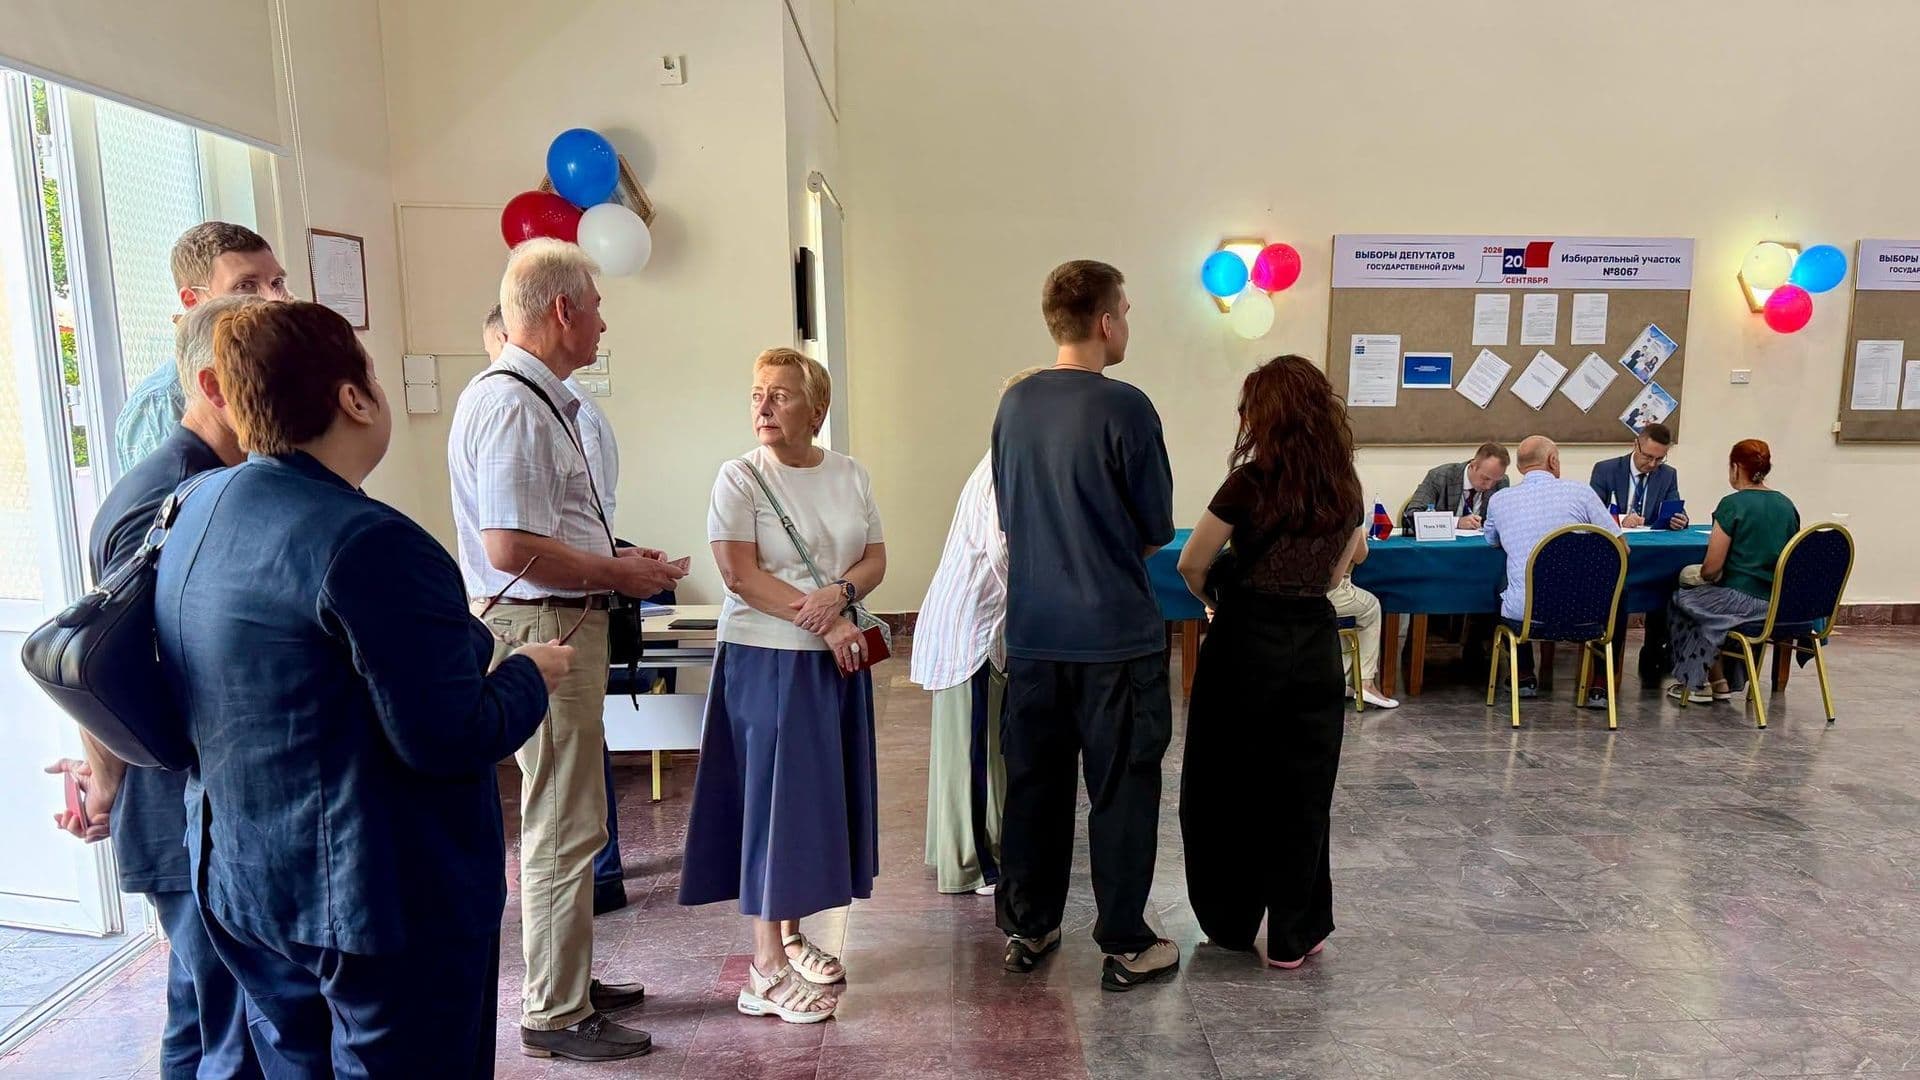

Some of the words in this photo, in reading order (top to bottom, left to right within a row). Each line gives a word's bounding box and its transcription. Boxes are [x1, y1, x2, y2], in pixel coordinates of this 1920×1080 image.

[1483, 246, 1503, 254] 2026
[1354, 251, 1397, 259] ВЫБОРЫ
[1399, 251, 1456, 260] ДЕПУТАТОВ
[1561, 254, 1640, 265] Избирательный
[1641, 256, 1681, 266] участок
[1879, 254, 1919, 263] ВЫБОРЫ
[1504, 255, 1523, 268] 20
[1366, 262, 1441, 271] ГОСУДАРСТВЕННОЙ
[1441, 263, 1465, 271] ДУМЫ
[1603, 267, 1639, 276] №8067
